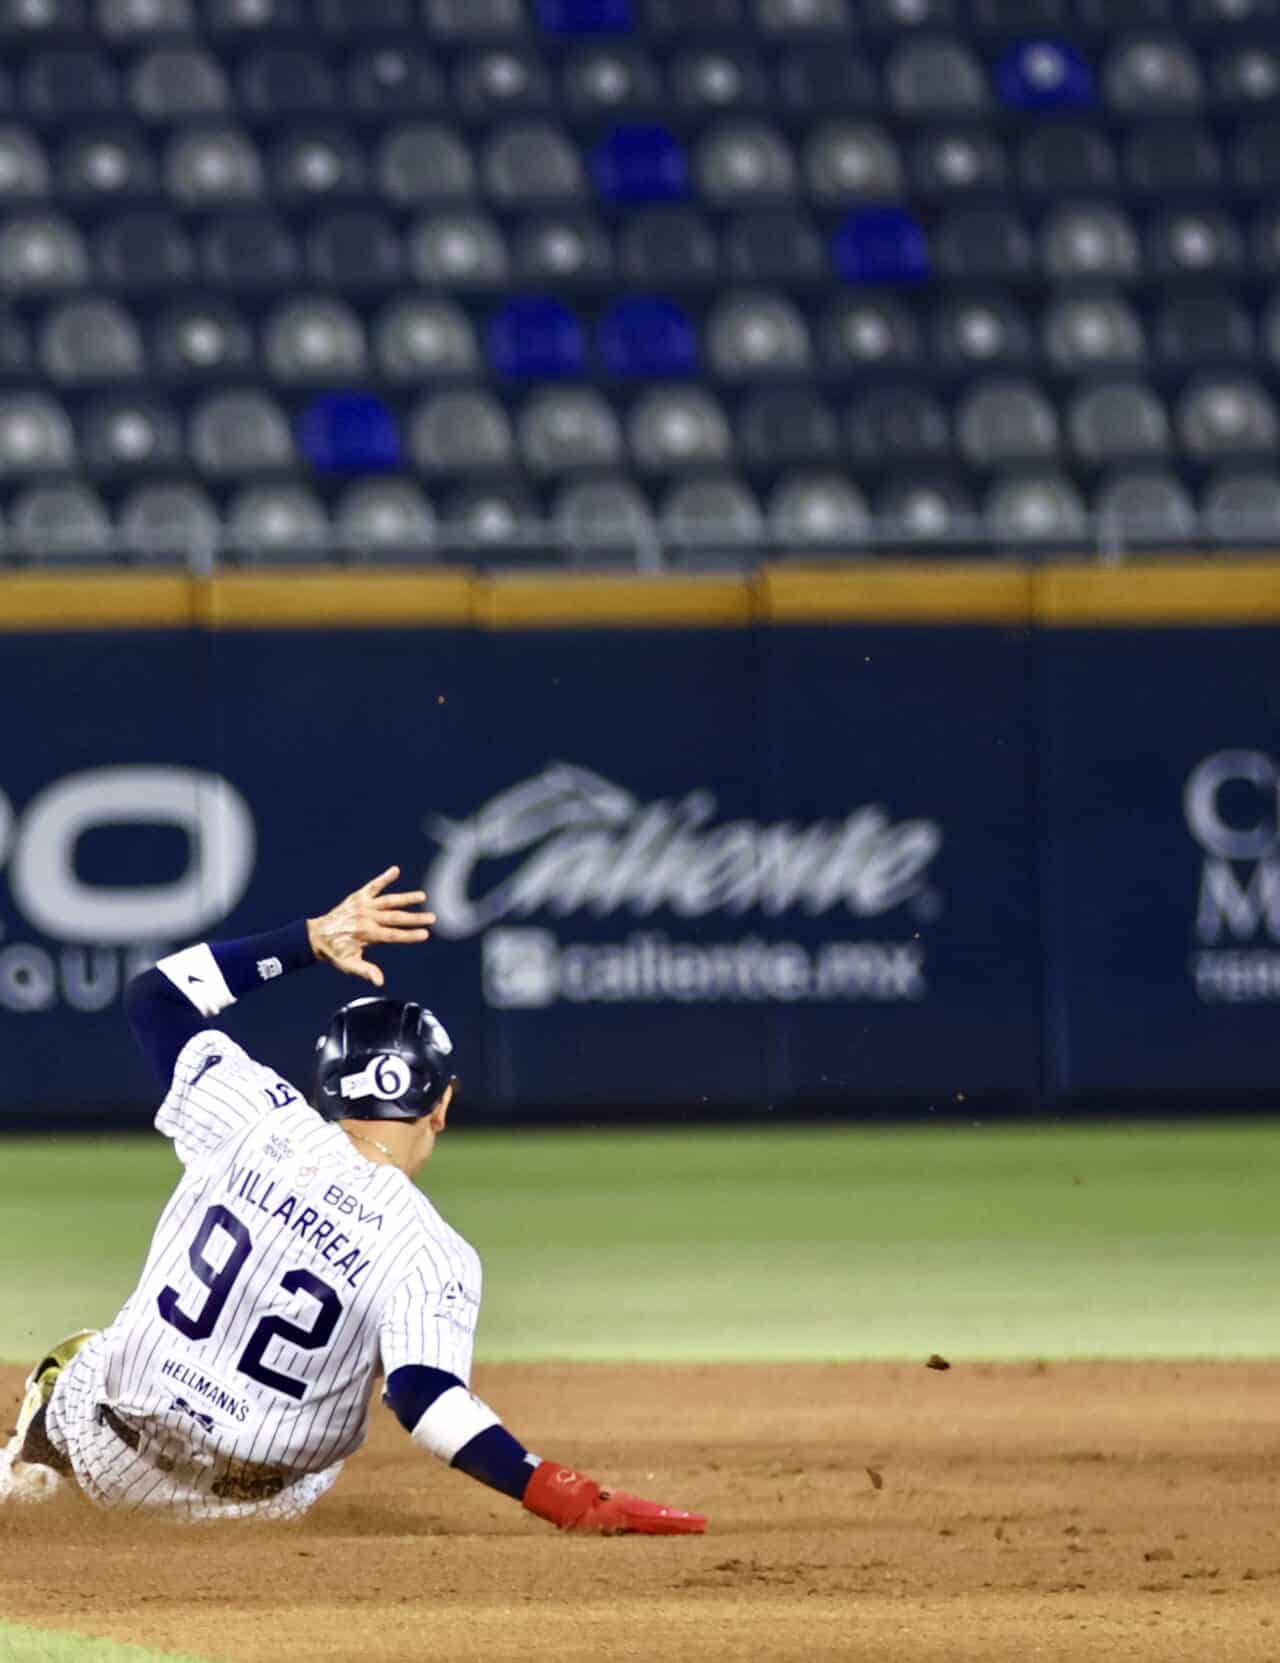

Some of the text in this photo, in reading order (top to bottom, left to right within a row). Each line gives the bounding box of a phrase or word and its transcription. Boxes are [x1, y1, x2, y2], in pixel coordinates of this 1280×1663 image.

[422, 762, 942, 940] Caliente
[558, 932, 924, 1000] caliente.mx
[374, 1054, 402, 1095] 6
[227, 1162, 370, 1289] VILLARREAL
[322, 1184, 384, 1232] BBVA
[157, 1204, 344, 1401] 92
[161, 1359, 250, 1423] HELLMANN'S
